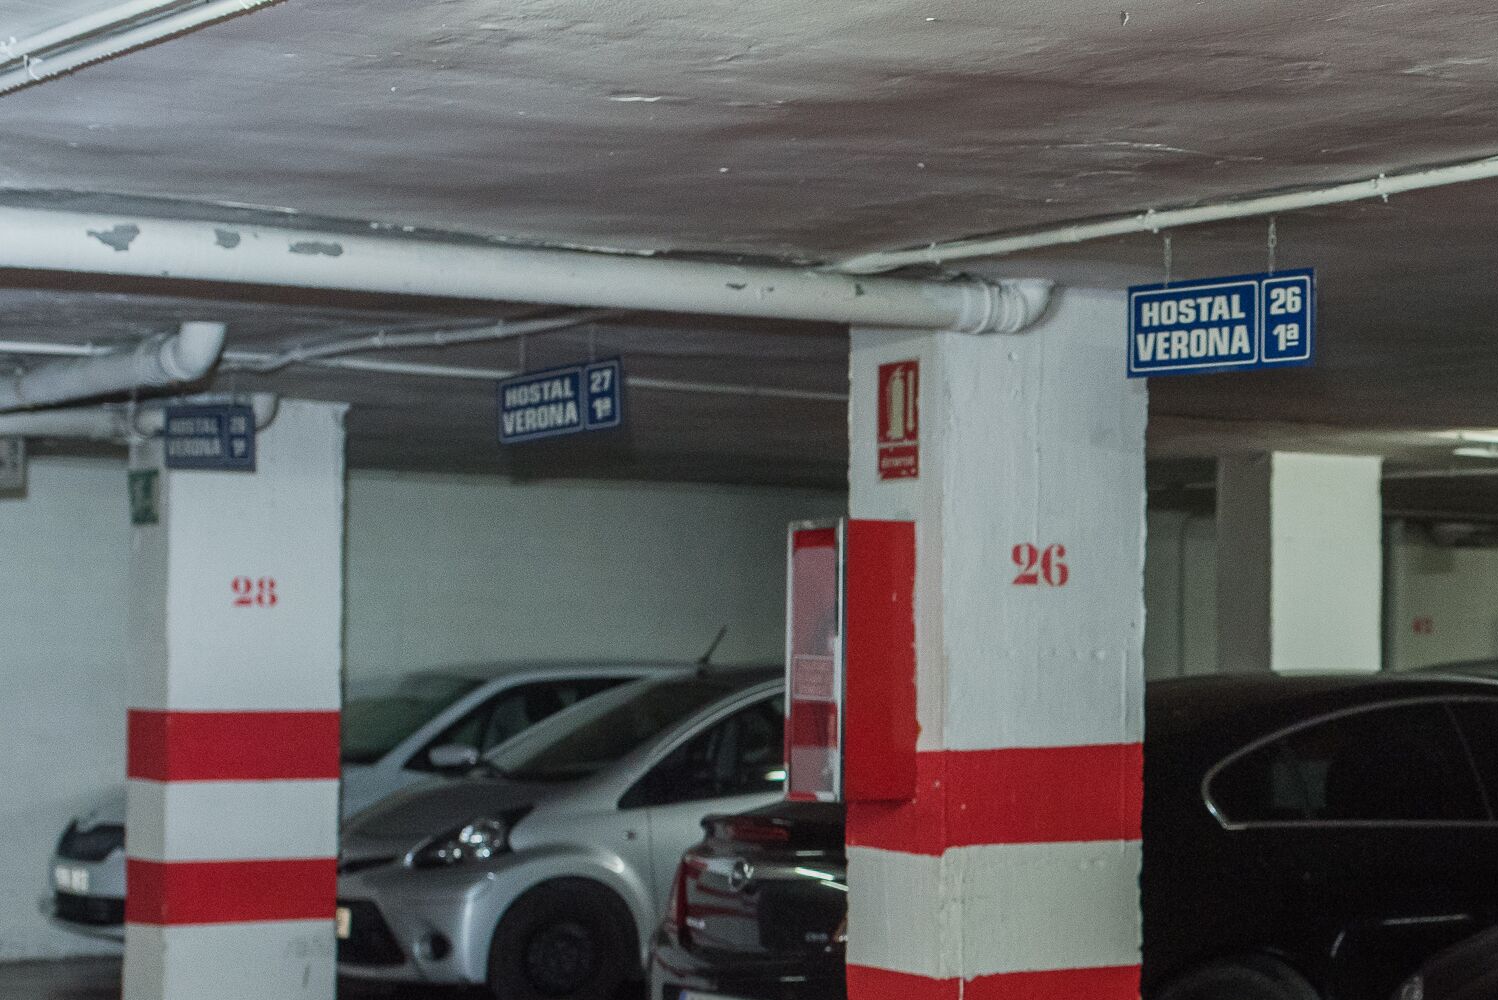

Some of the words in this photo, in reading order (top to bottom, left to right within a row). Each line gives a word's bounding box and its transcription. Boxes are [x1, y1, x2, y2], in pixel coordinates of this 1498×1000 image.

[1141, 294, 1246, 327] HOSTAL
[1270, 286, 1301, 315] 26
[1136, 325, 1250, 362] VERONA
[504, 376, 574, 408] HOSTAL
[590, 368, 612, 393] 27
[503, 400, 578, 435] VERONA
[1011, 542, 1069, 587] 26
[231, 576, 278, 608] 28
